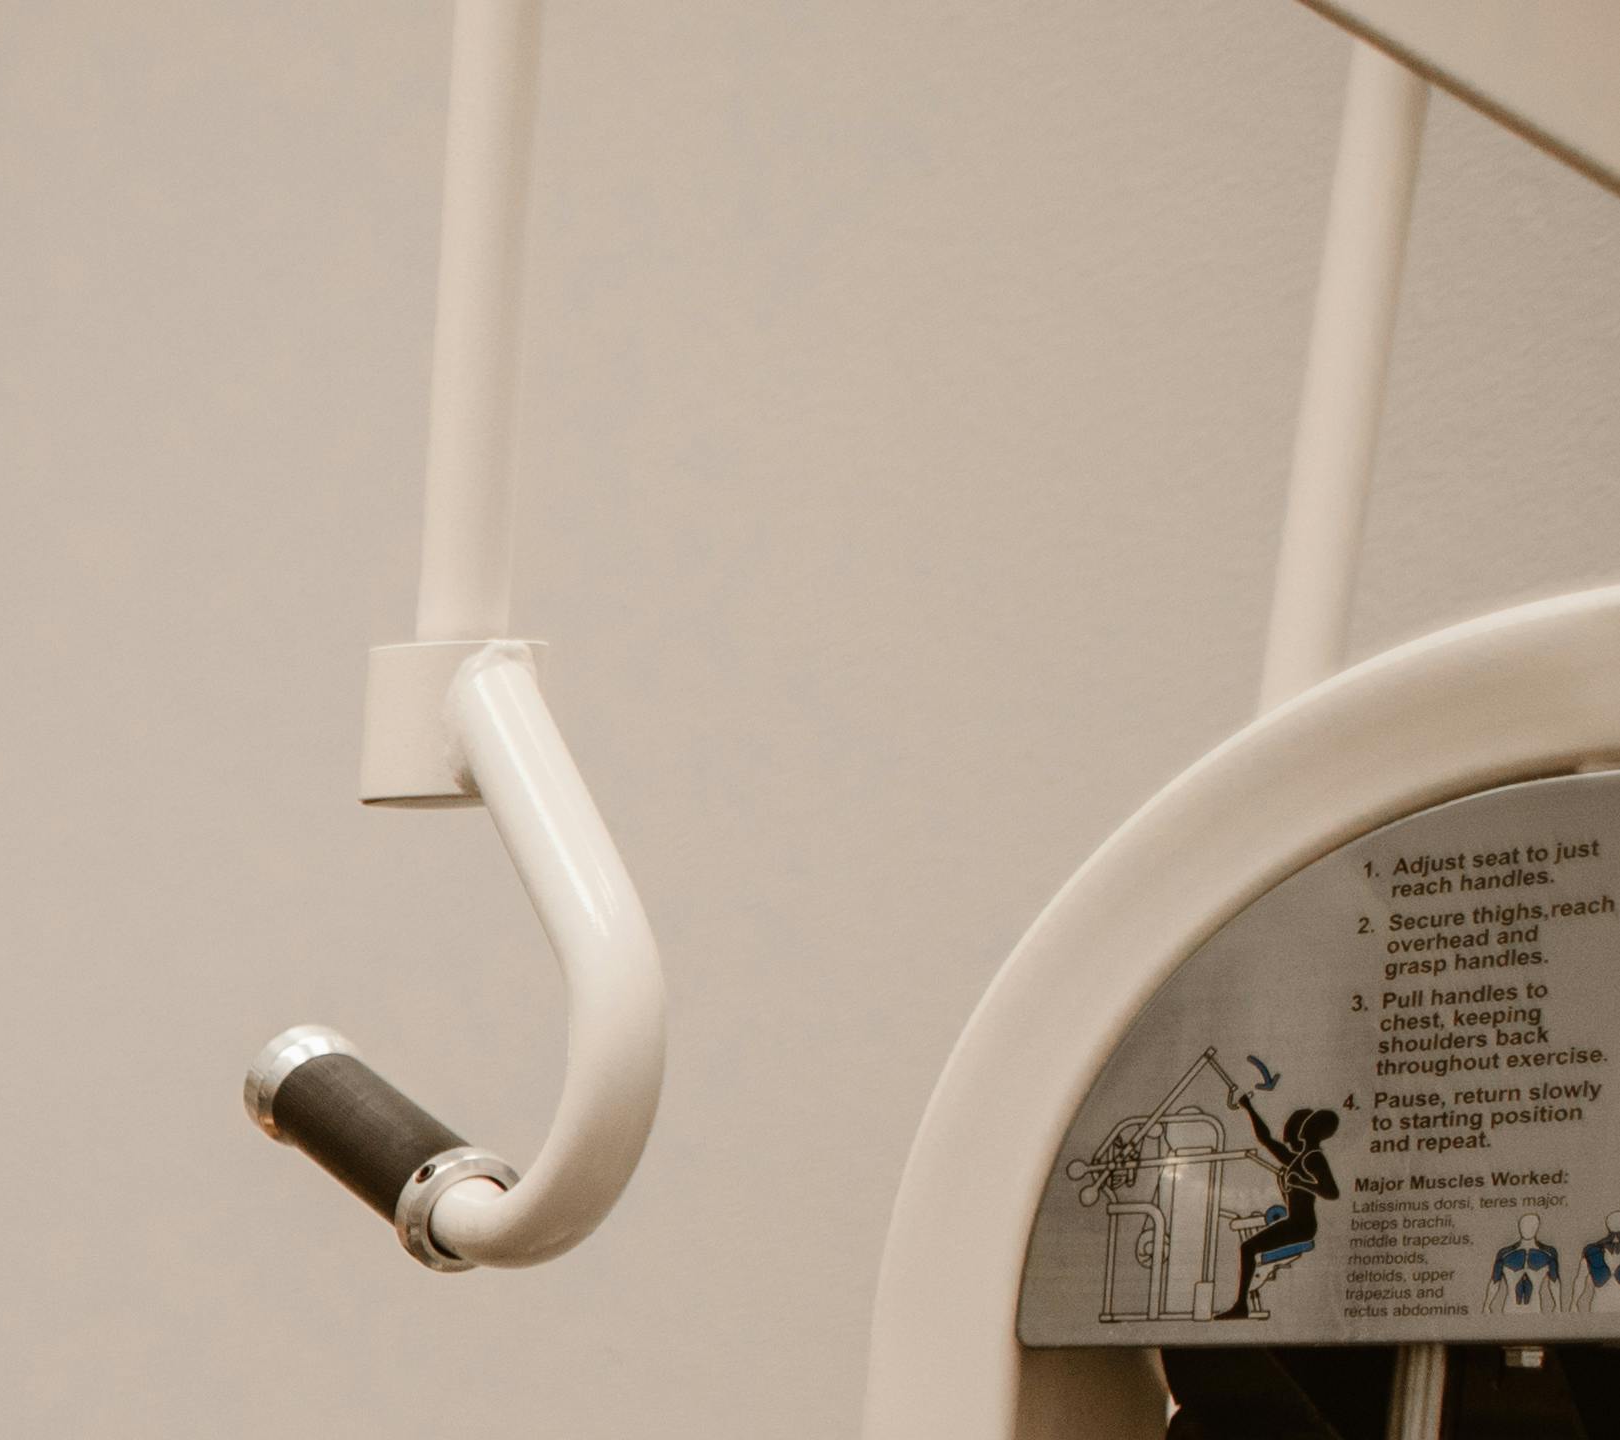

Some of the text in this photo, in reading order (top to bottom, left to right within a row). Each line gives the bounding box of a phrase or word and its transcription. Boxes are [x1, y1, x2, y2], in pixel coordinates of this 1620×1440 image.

[1363, 840, 1600, 879] 1. Adjust seat to just
[1392, 869, 1555, 898] reach handles.
[1357, 917, 1375, 934] 2.
[1389, 911, 1465, 932] Secure
[1387, 925, 1539, 954] overhead and
[1385, 949, 1549, 980] grasp handles.
[1351, 983, 1548, 1012] 3. Pull handles to
[1380, 1007, 1542, 1032] chest, keeping
[1378, 1027, 1549, 1054] shoulders back
[1376, 1047, 1608, 1077] throughout exercise.
[1343, 1080, 1602, 1111] 4. Pause, return slowly
[1372, 1105, 1583, 1131] to starting position
[1369, 1132, 1491, 1153] and repeat.
[1354, 1169, 1570, 1195] Major Muscles Worked:
[1352, 1199, 1429, 1213] Latissimus
[1434, 1196, 1474, 1211] dorsi,
[1479, 1196, 1516, 1209] teres
[1351, 1217, 1397, 1233] biceps
[1350, 1234, 1397, 1248] middle
[1346, 1269, 1455, 1283] deltoids, upper
[1346, 1286, 1444, 1302] trapezius and
[1344, 1303, 1469, 1317] rectus abdominis
